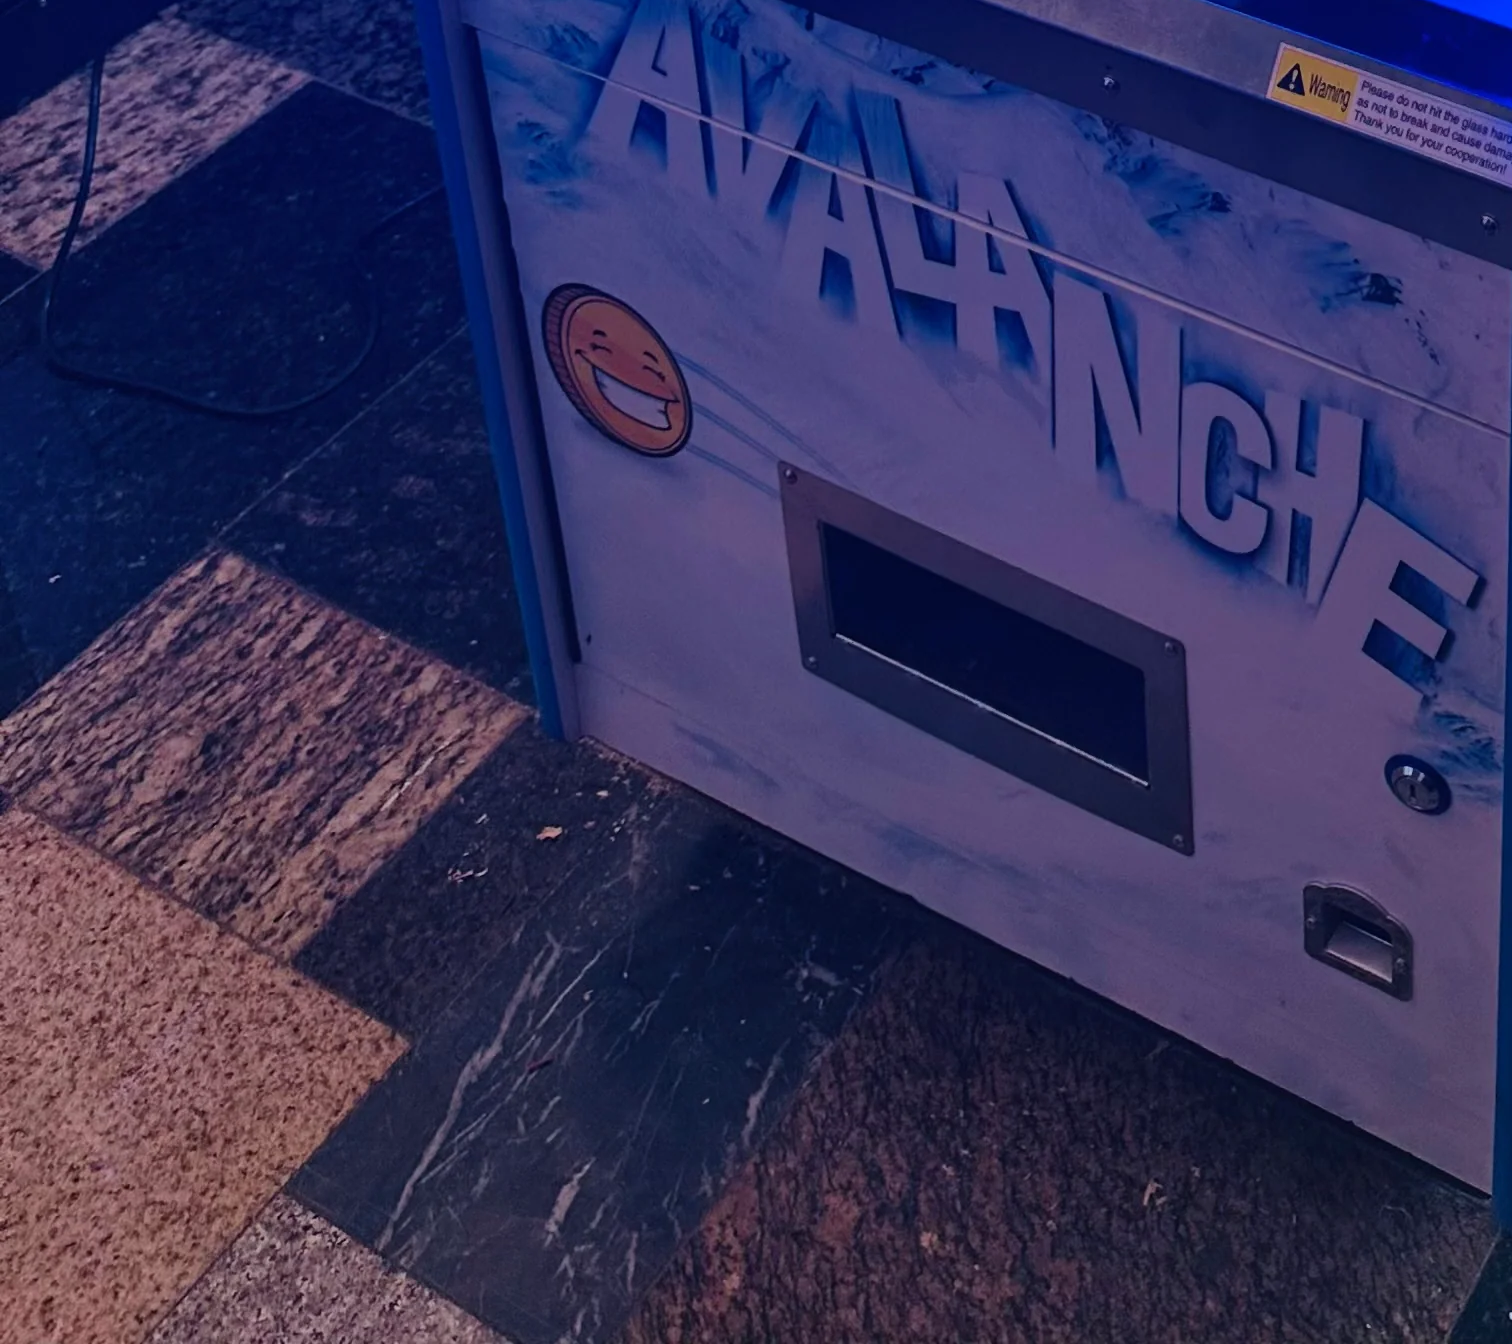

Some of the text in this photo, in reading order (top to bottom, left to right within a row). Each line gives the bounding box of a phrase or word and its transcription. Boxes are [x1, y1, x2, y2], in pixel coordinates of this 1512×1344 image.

[1308, 72, 1351, 112] Warning
[1361, 80, 1395, 102] Please
[1398, 91, 1410, 106] do
[1411, 98, 1427, 113] not
[1429, 102, 1443, 119] hit
[1444, 108, 1460, 124] the
[1461, 115, 1489, 136] glass
[1354, 110, 1508, 175] Thank you for your cooperation!
[1356, 98, 1369, 109] as
[1371, 101, 1387, 116] not
[1388, 106, 1399, 119] to
[1400, 109, 1428, 131] break
[1429, 118, 1449, 137] and
[1451, 129, 1482, 150] cause
